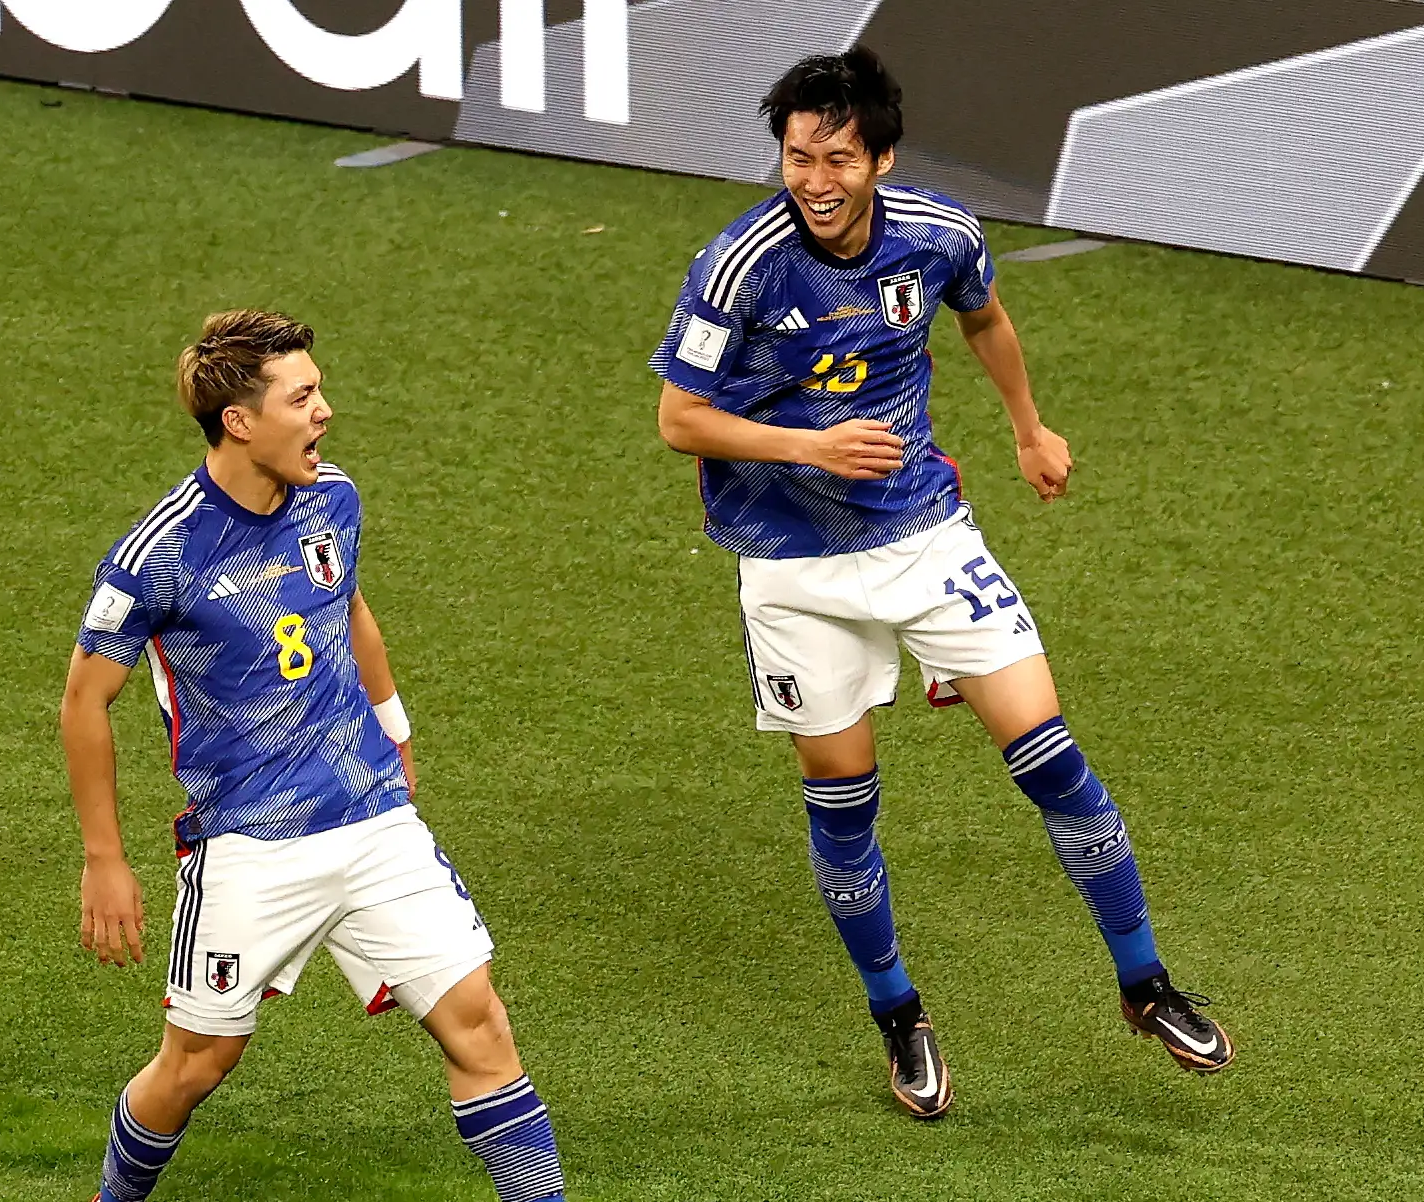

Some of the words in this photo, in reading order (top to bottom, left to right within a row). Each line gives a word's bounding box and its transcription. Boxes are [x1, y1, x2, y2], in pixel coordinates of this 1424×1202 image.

[942, 555, 1018, 623] 15
[273, 612, 314, 681] 8
[1086, 820, 1125, 858] JAP
